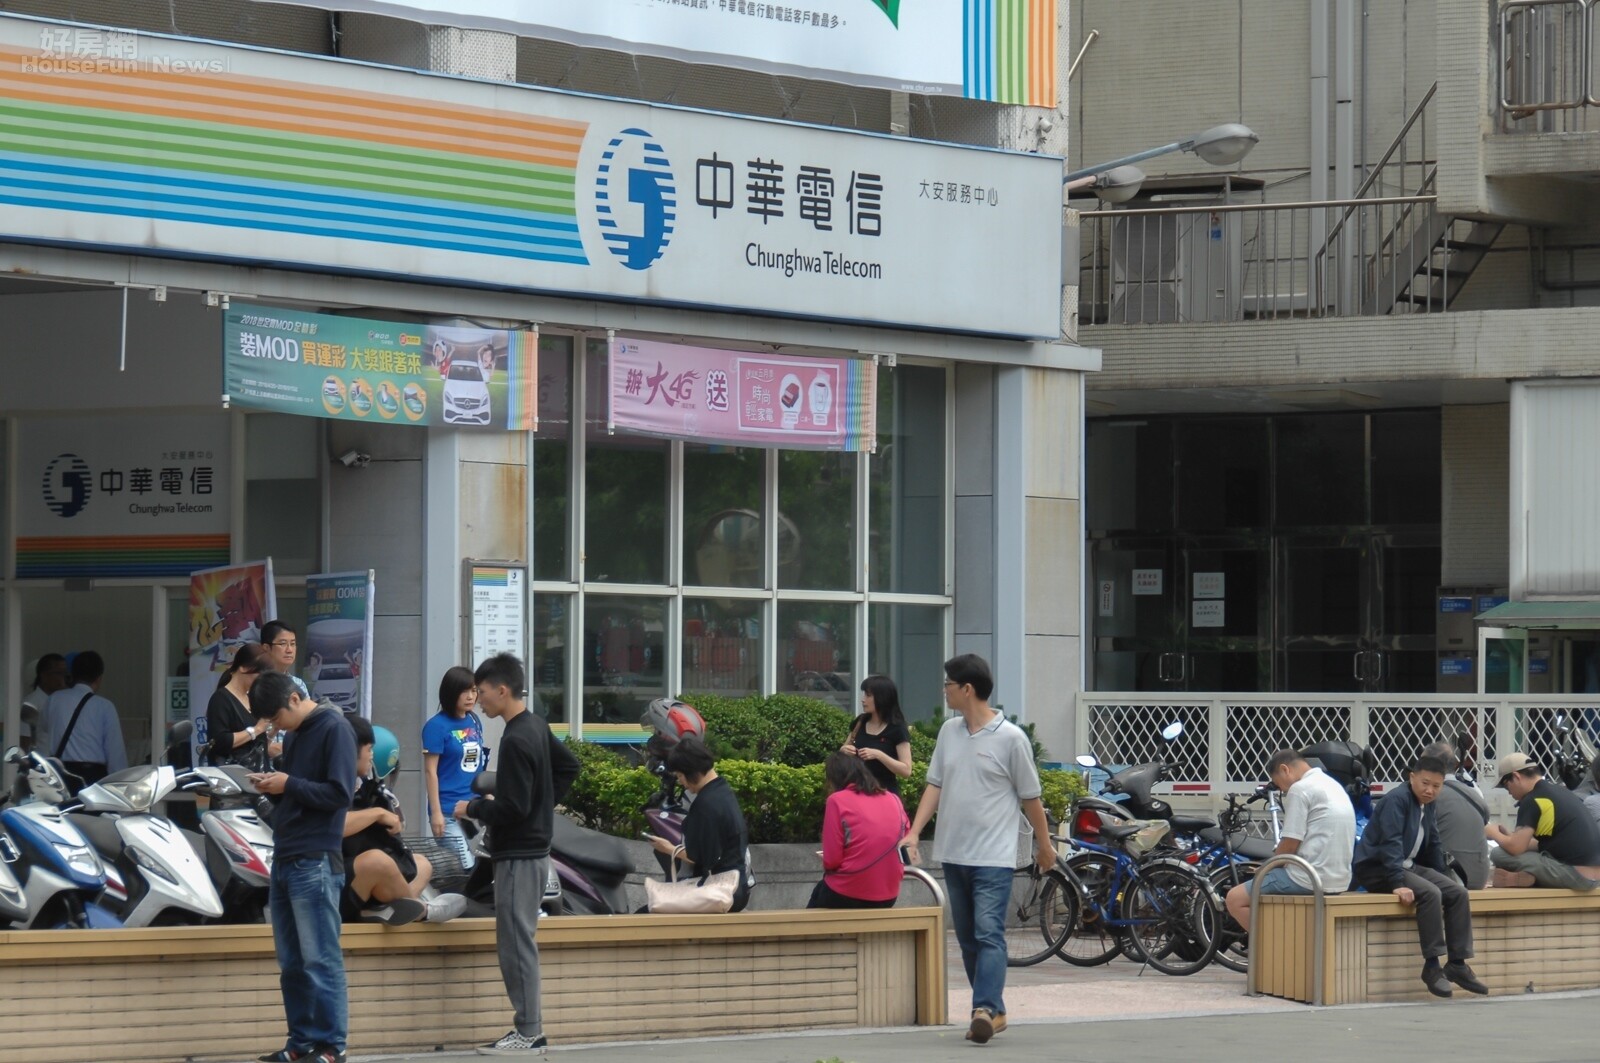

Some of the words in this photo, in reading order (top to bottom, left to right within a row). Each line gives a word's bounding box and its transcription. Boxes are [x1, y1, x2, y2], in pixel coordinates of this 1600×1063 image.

[696, 151, 884, 237] 中華電信
[919, 179, 998, 206] 大安服務中心
[745, 242, 821, 278] Chunghwa
[822, 250, 882, 279] Telecom
[240, 332, 299, 362] 裝MOD
[302, 341, 347, 369] 買運彩
[350, 346, 422, 375] 大獎跟著來
[707, 371, 728, 411] 送
[752, 386, 771, 405] 時尚
[101, 466, 213, 495] 中華電信
[129, 503, 175, 517] Chunghwa
[176, 503, 213, 513] Telecom
